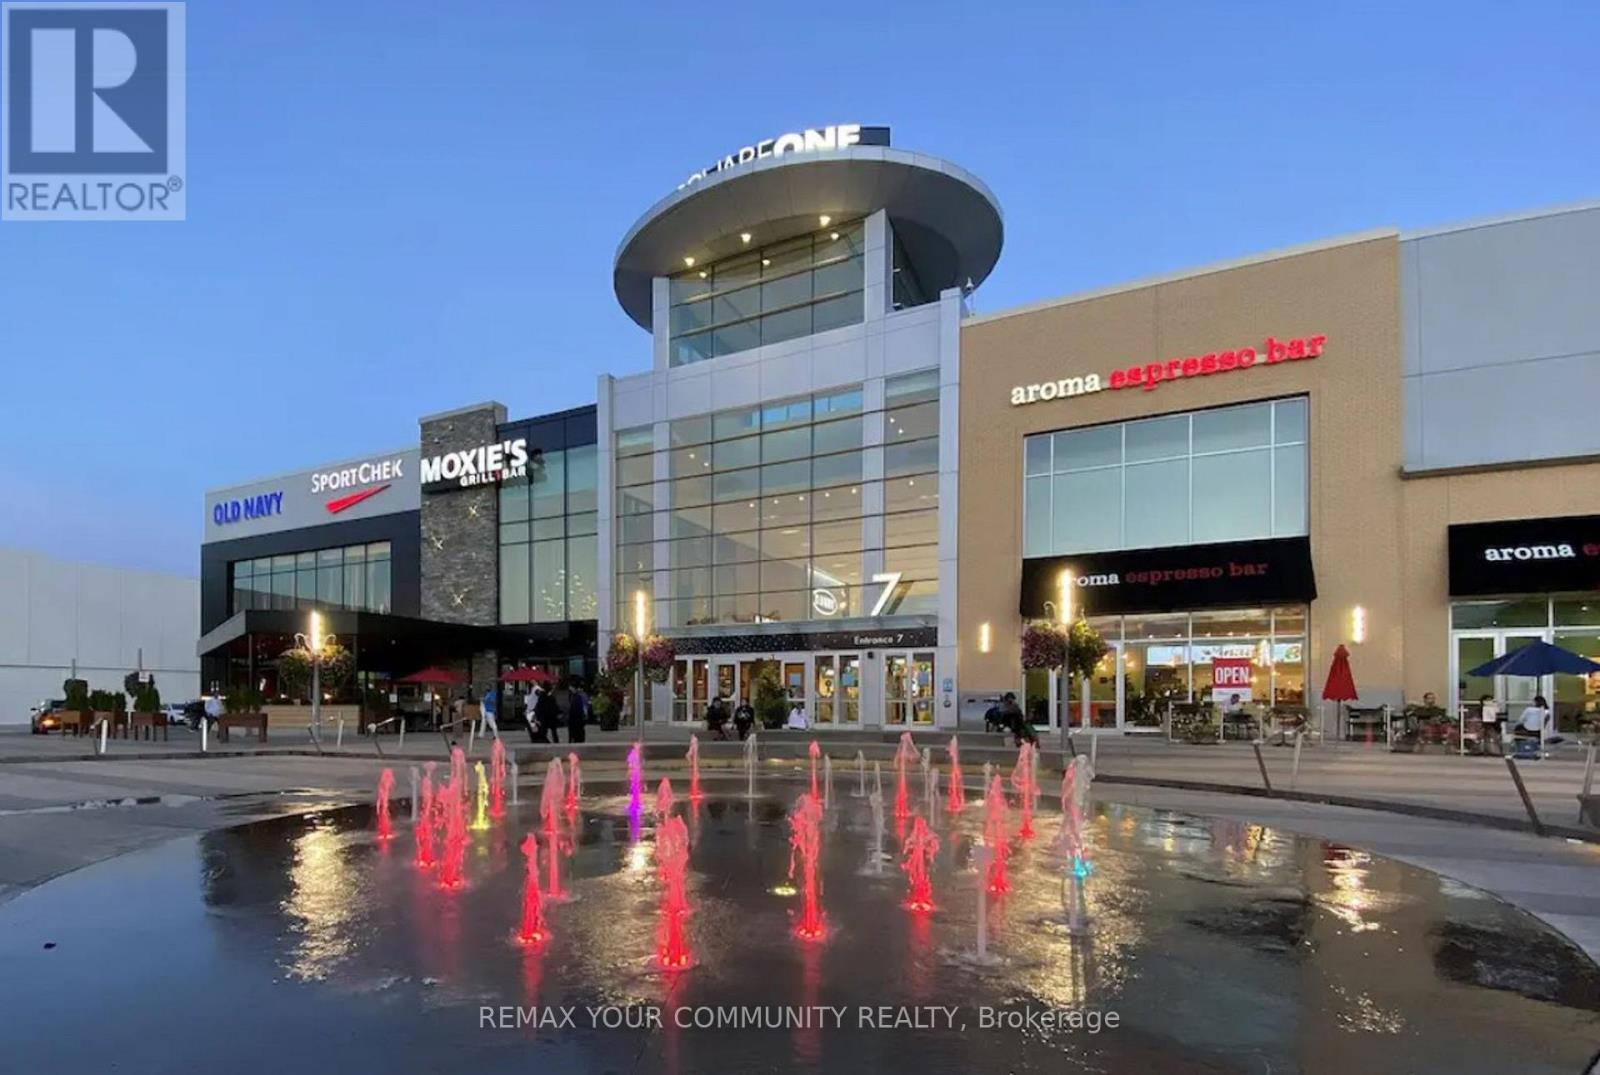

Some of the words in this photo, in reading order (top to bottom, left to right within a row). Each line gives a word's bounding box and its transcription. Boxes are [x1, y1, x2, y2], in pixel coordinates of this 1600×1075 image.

[1010, 372, 1102, 406] aroma
[1108, 346, 1258, 391] espresso
[1266, 333, 1327, 363] bar
[420, 438, 528, 484] MOXIE'S
[460, 470, 496, 487] GRILL
[502, 465, 527, 481] BAR
[213, 500, 241, 526] OLD
[244, 491, 283, 520] NAVY
[1484, 543, 1576, 562] aroma
[1125, 566, 1224, 586] espresso
[1228, 561, 1269, 577] bar
[870, 571, 902, 616] 7
[853, 635, 894, 646] Entrance
[896, 633, 904, 643] 7
[1214, 666, 1250, 684] OPEN
